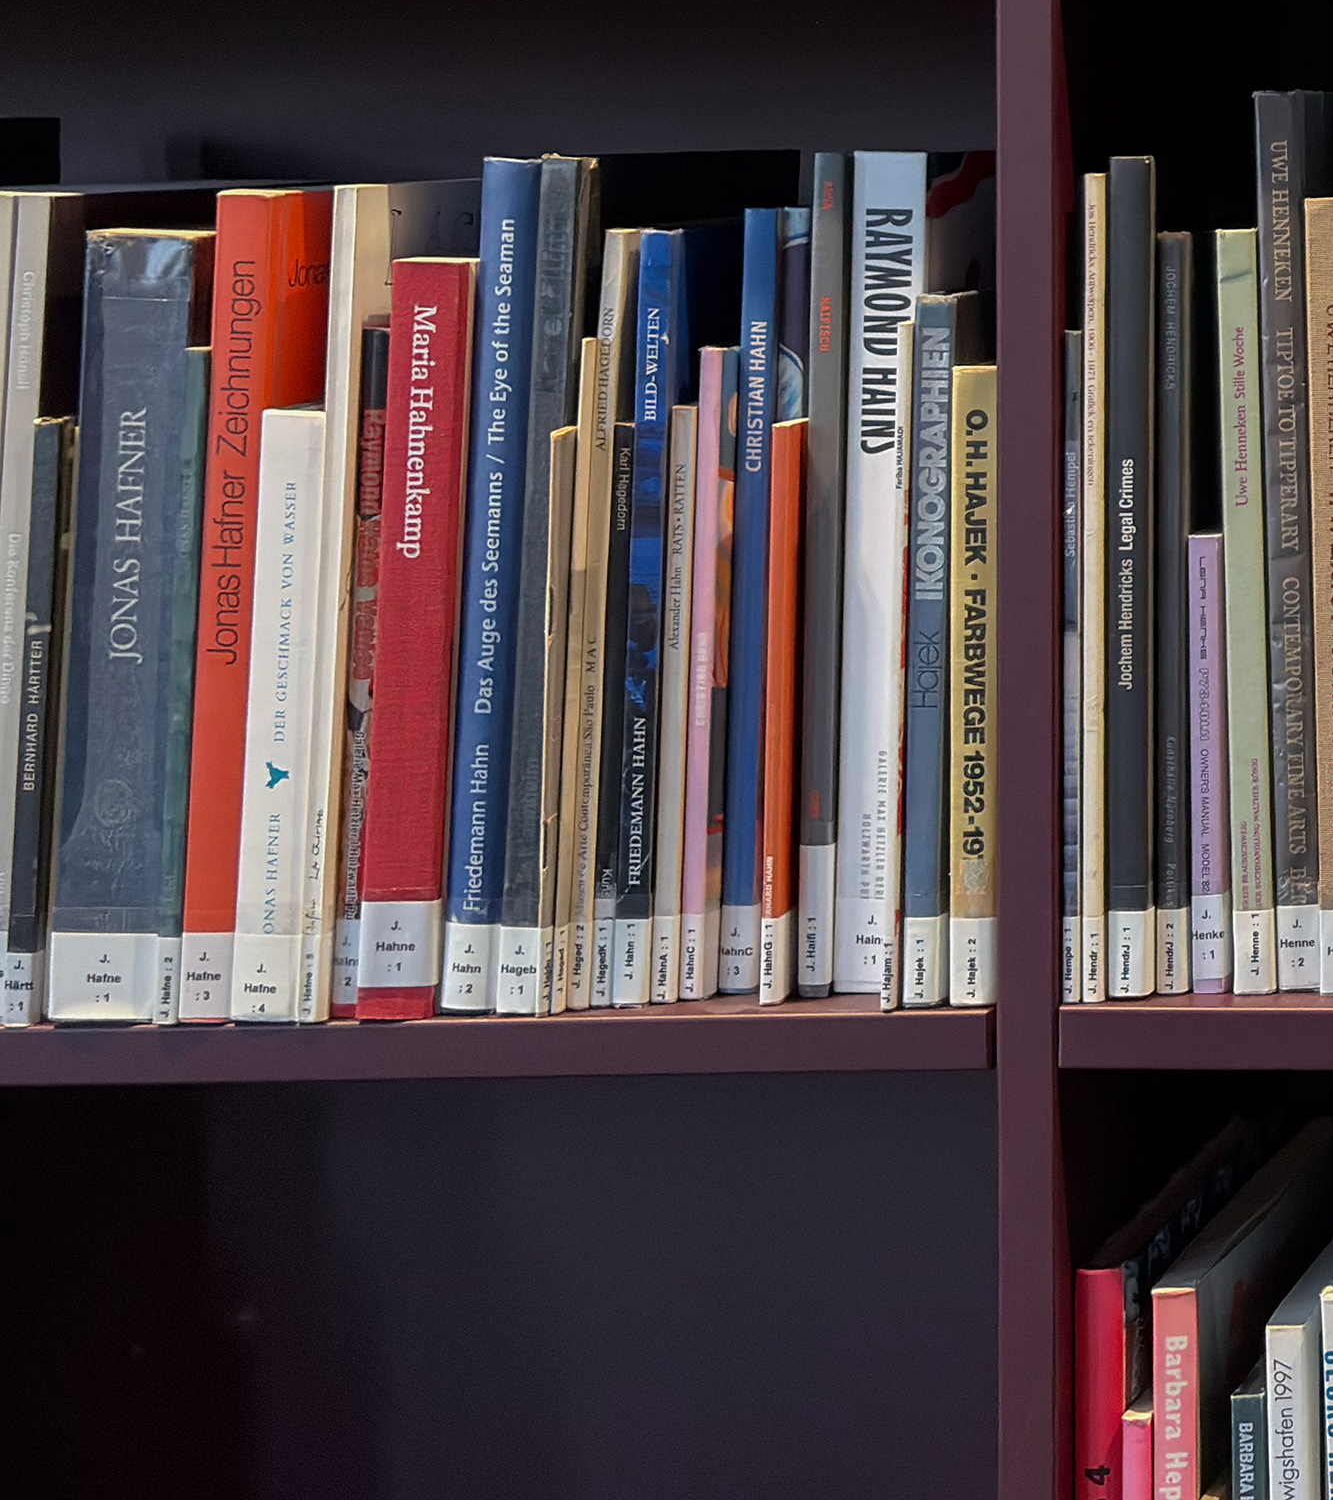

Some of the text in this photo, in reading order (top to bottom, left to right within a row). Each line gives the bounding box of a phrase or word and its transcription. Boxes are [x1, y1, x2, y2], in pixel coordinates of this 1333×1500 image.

[495, 219, 516, 294] Seaman
[493, 299, 511, 335] the
[493, 339, 510, 359] of
[861, 207, 913, 456] RAYMOND HAINS
[396, 305, 438, 560] Maria Hahnenkamp
[488, 406, 506, 446] The
[490, 363, 511, 402] Eye
[746, 321, 767, 472] CHRISTIAN HAHN
[1233, 325, 1249, 508] Uwe Henneken Stille Woche
[206, 260, 260, 666] Jonas Hafner Zeichnungen
[916, 328, 951, 601] IKONOGRAPHIEN
[109, 406, 147, 665] JONAS HAFNER
[481, 471, 503, 573] Seemanns
[479, 577, 497, 620] des
[1119, 458, 1136, 691] Jochem Hendricks Legal Crimes
[474, 674, 493, 715] Das
[477, 617, 500, 669] Auge
[470, 743, 490, 800] Hahn
[463, 802, 488, 912] Friedemann
[1158, 1335, 1188, 1440] Barbara
